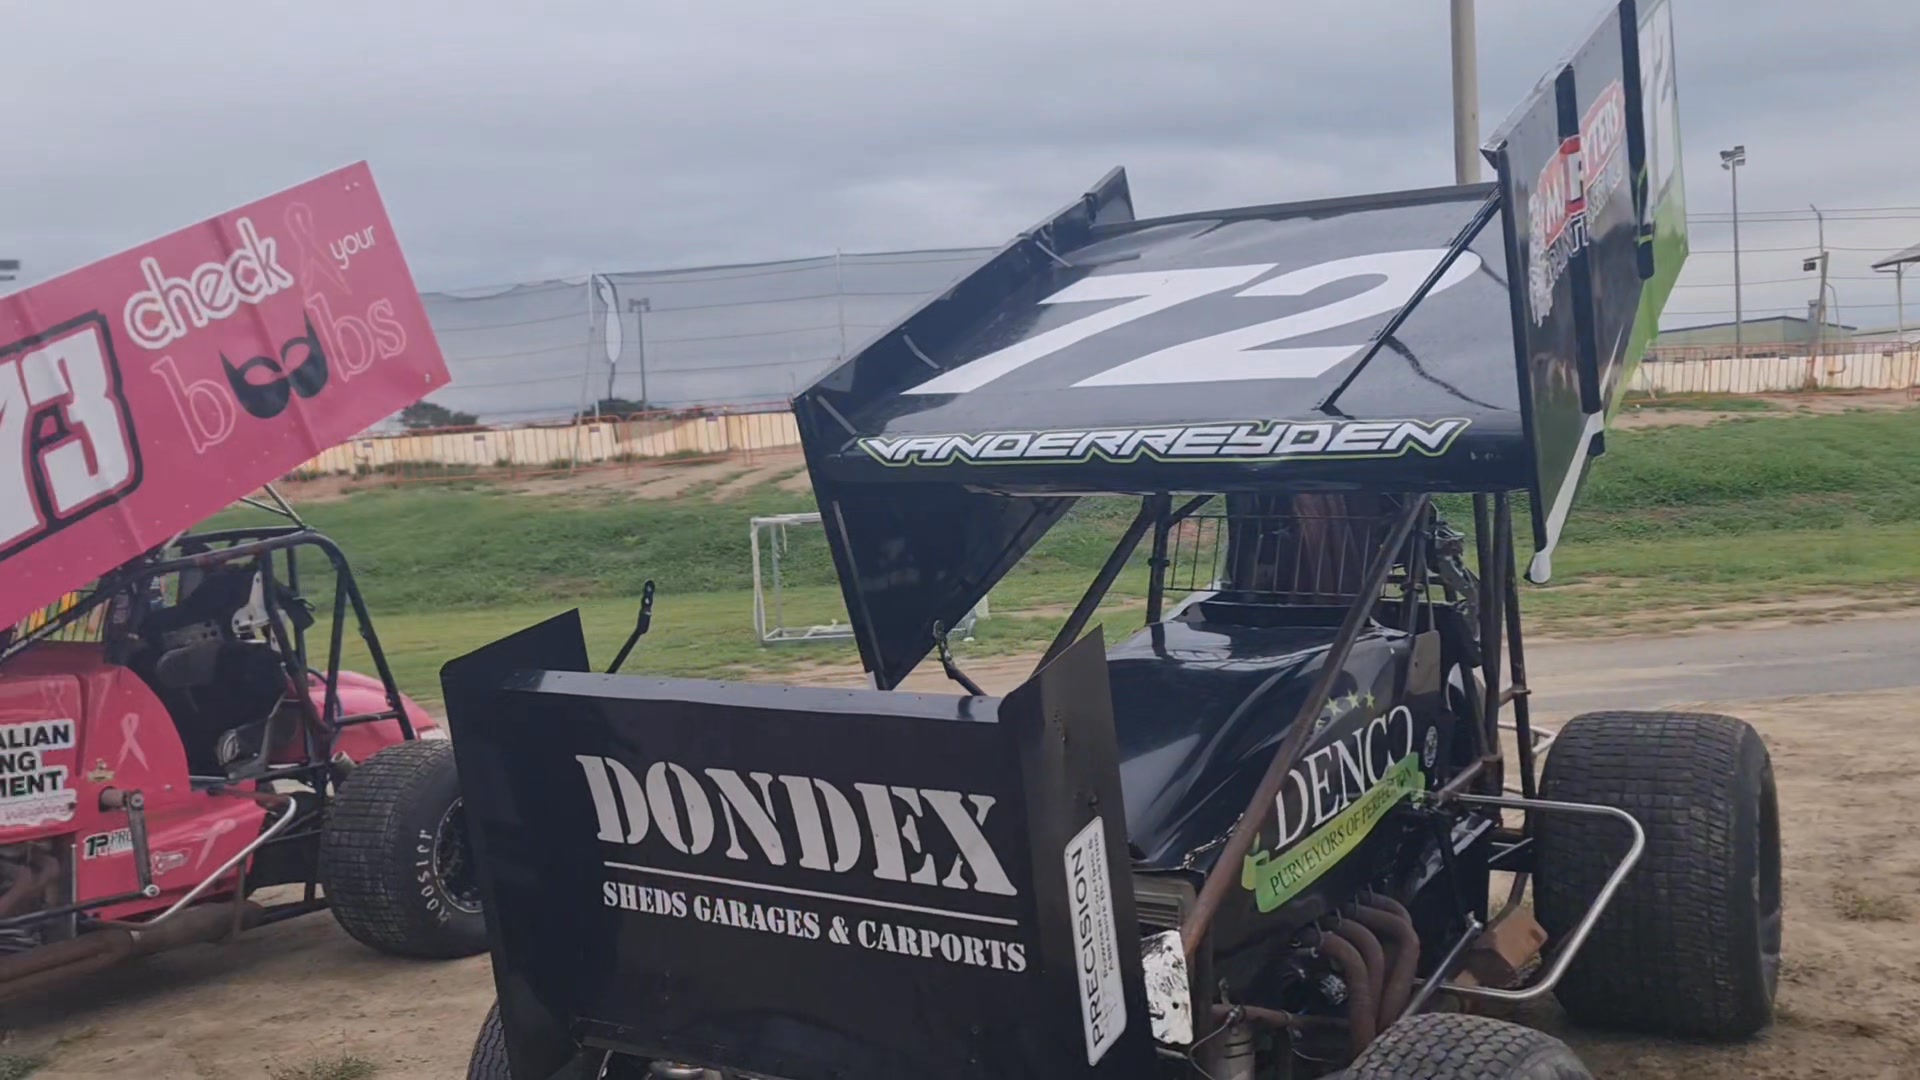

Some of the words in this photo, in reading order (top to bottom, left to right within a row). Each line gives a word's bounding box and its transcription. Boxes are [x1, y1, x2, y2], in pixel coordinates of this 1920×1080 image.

[124, 217, 293, 349] check
[329, 225, 376, 270] your
[900, 248, 1482, 396] 72
[860, 419, 1470, 463] VANDERREYDEN
[576, 754, 1018, 896] DONDEX
[1274, 705, 1413, 851] DENCO
[1269, 824, 1345, 896] PURVEYORS
[603, 881, 687, 919] SHEDS
[693, 895, 821, 940] GARAGES
[828, 916, 851, 945] &
[857, 920, 1027, 973] CARPORTS
[1071, 847, 1105, 1048] PRECISION
